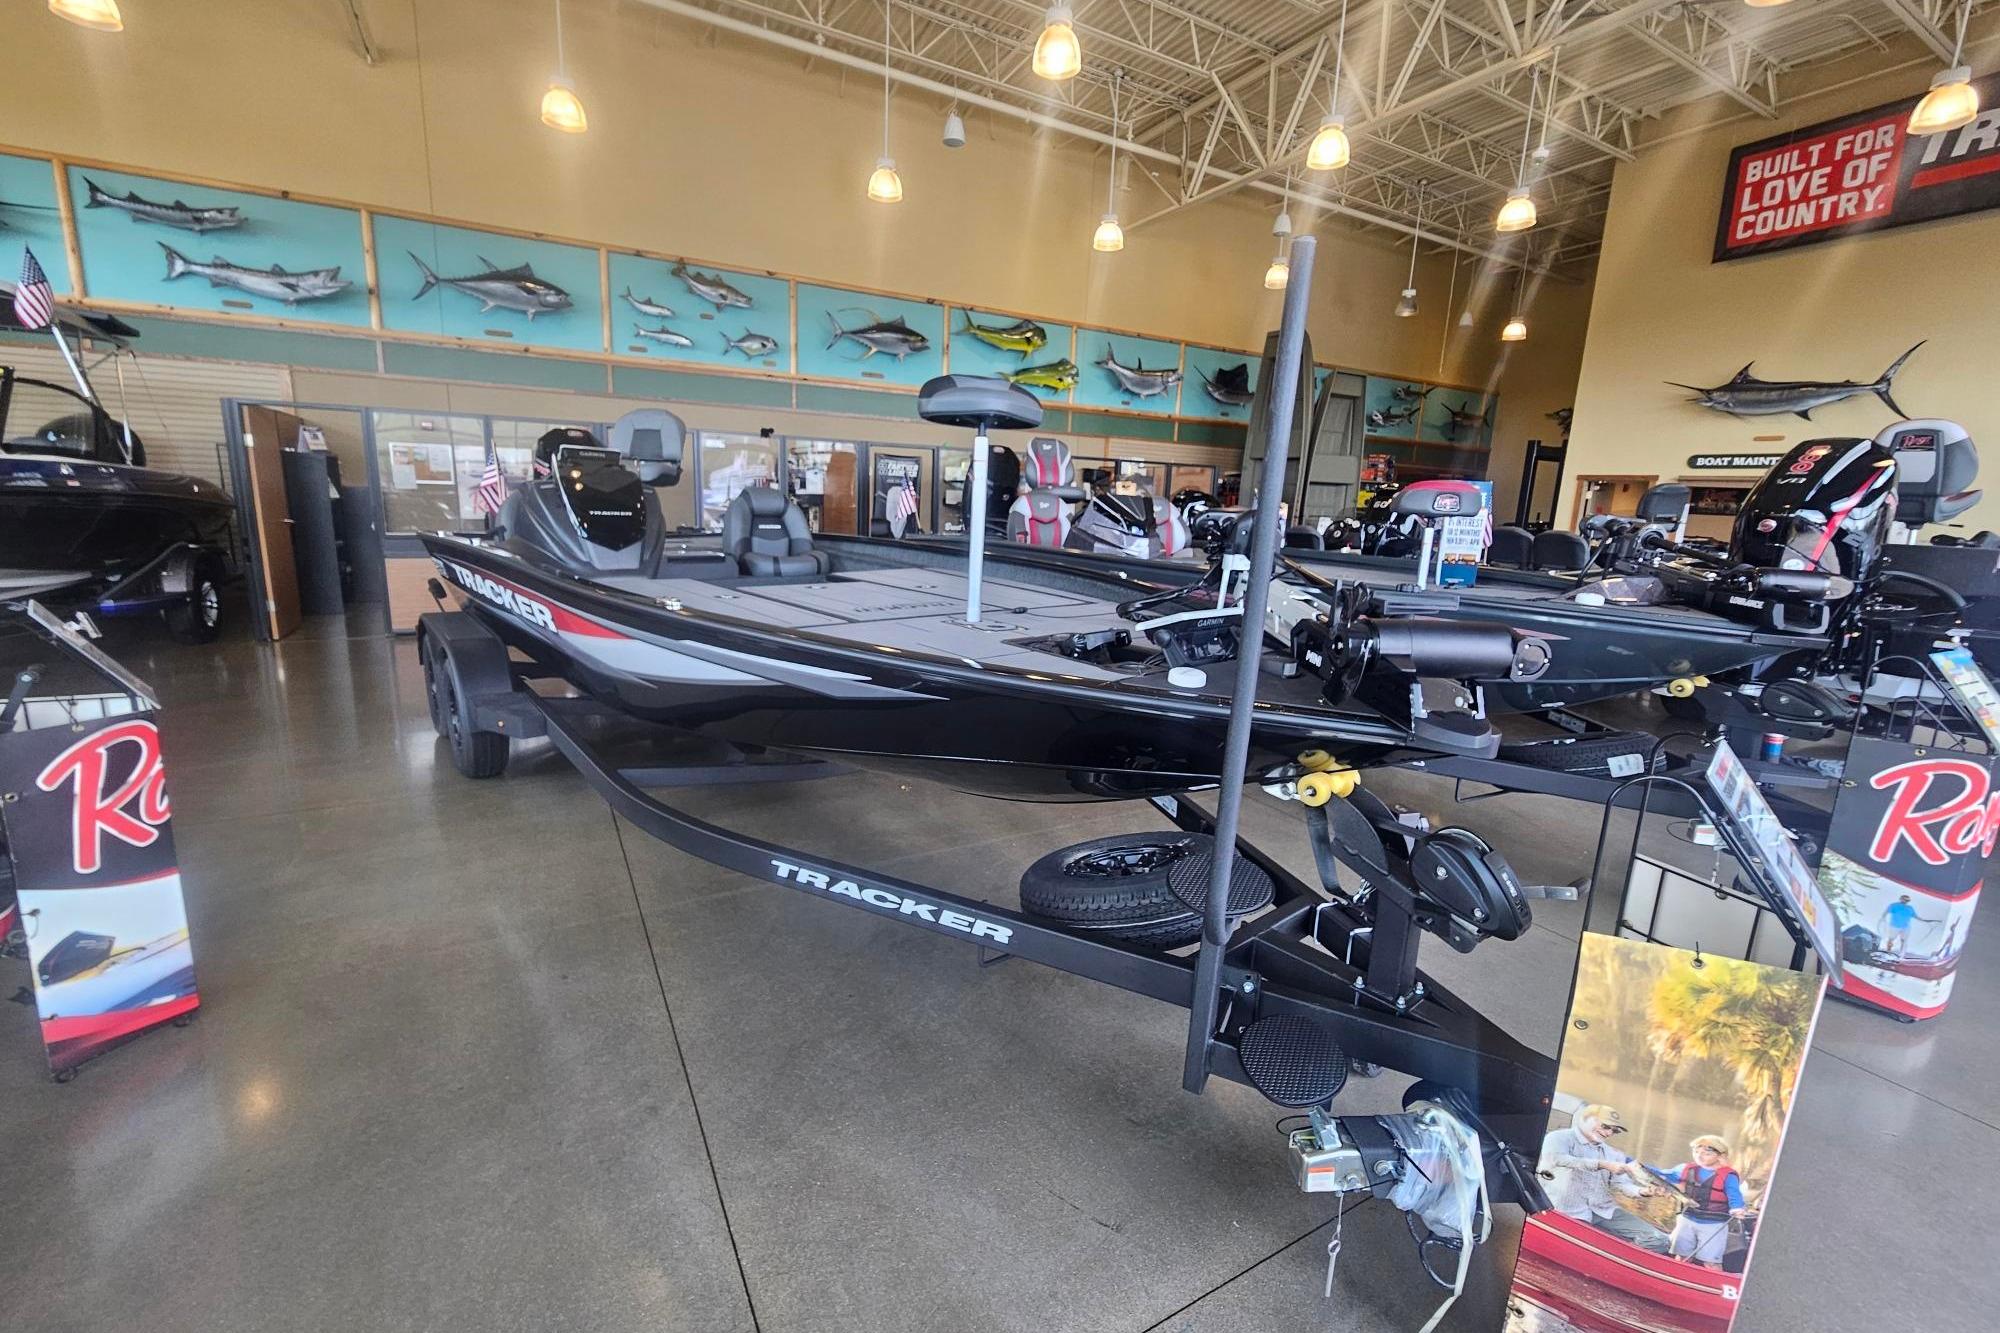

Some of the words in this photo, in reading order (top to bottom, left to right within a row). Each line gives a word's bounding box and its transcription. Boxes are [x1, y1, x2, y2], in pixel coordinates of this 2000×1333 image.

[1746, 142, 1826, 184] BUILT
[1834, 124, 1896, 162] FOR
[1920, 108, 2000, 165] TR
[1740, 167, 1832, 214] LOVE
[1842, 151, 1892, 189] OF
[1735, 184, 1886, 240] COUNTRY.
[1696, 457, 1731, 466] BOAT
[450, 562, 558, 633] TRACKER
[1197, 617, 1225, 628] GARMIN
[771, 859, 1014, 944] TRACKER
